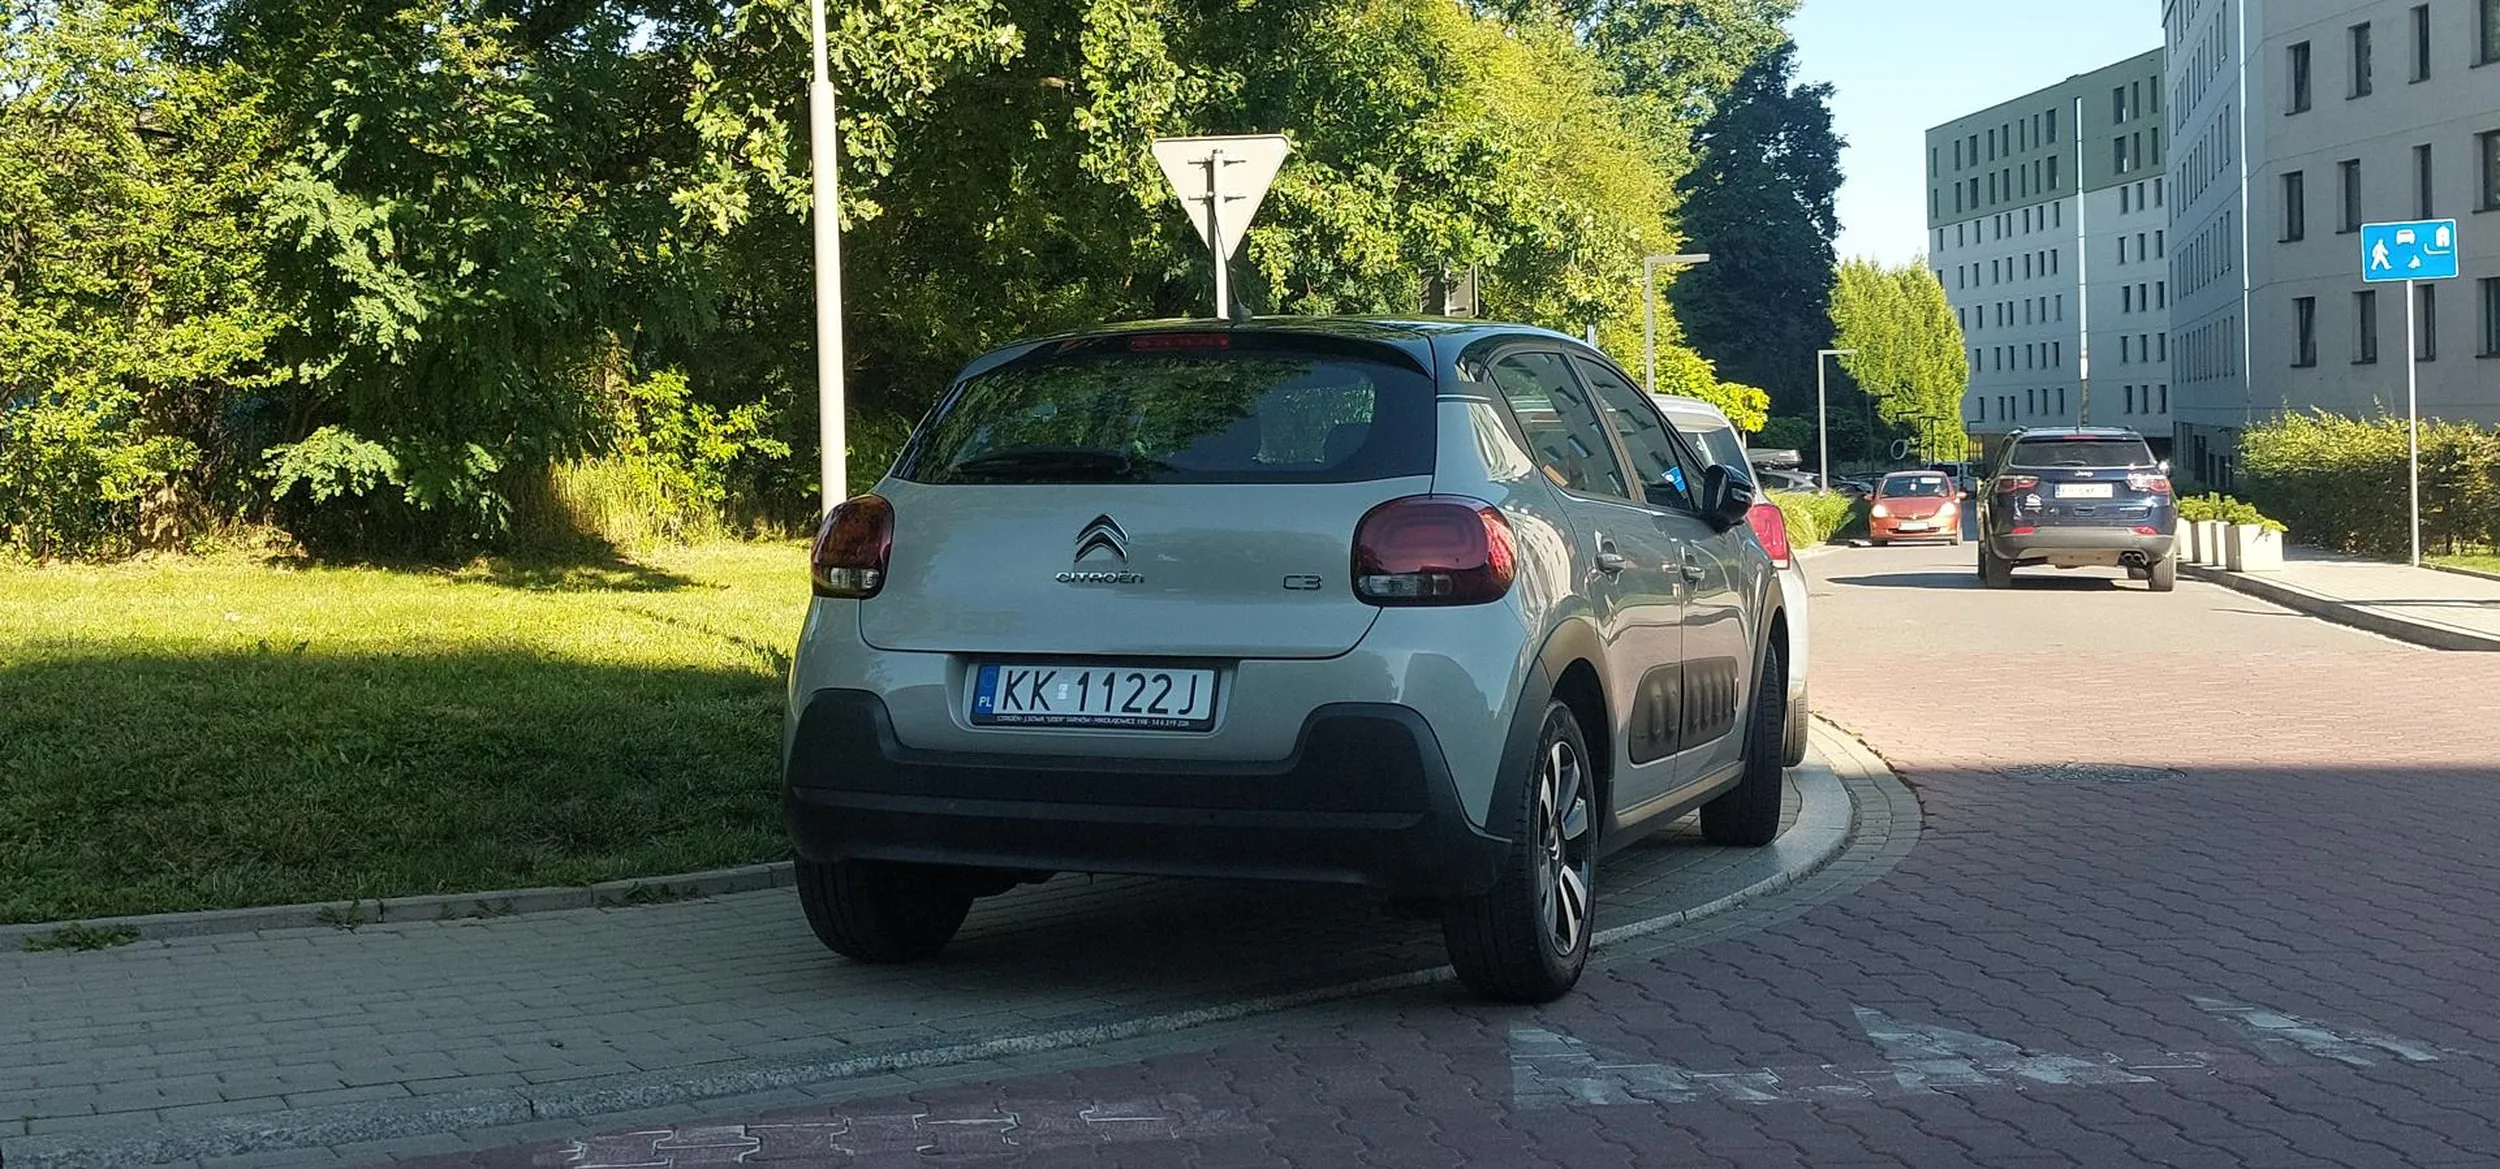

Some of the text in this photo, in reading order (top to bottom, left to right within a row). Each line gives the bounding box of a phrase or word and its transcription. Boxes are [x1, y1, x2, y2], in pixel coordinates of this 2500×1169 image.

[1283, 574, 1323, 591] C3
[1002, 670, 1198, 715] KK 1122J
[978, 696, 992, 708] PL
